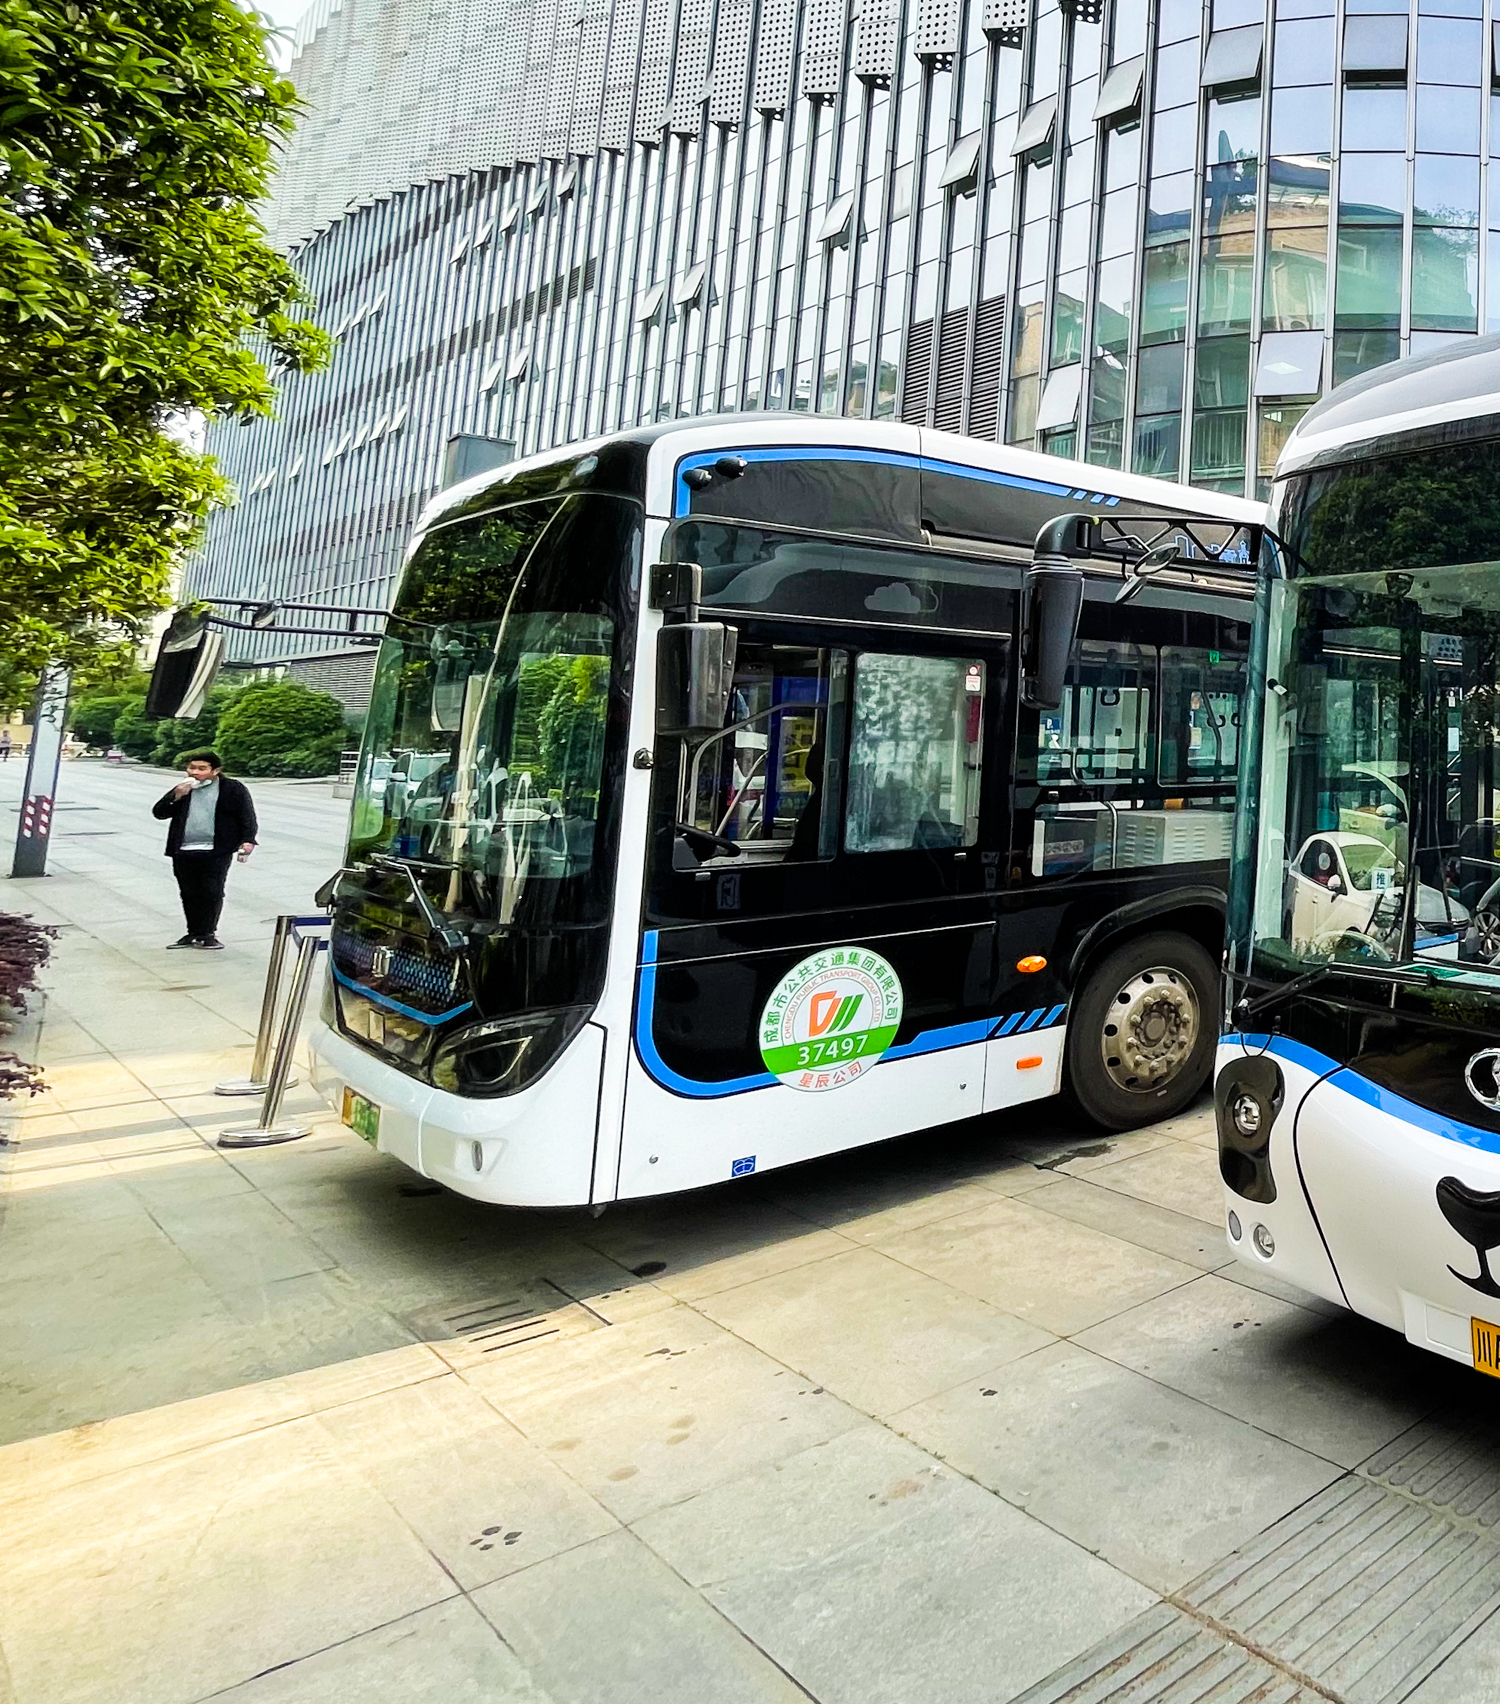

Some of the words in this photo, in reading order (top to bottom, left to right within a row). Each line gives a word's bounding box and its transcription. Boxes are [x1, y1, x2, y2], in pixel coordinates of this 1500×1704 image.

[763, 951, 898, 1044] 成都市公共交通集团有限公司
[784, 1001, 799, 1039] CHENGDU
[797, 978, 820, 1001] PUBLIC
[819, 970, 862, 983] TRANSPORT
[861, 975, 879, 996] GROUP
[797, 1034, 868, 1065] 37497
[798, 1061, 863, 1088] 星辰公司
